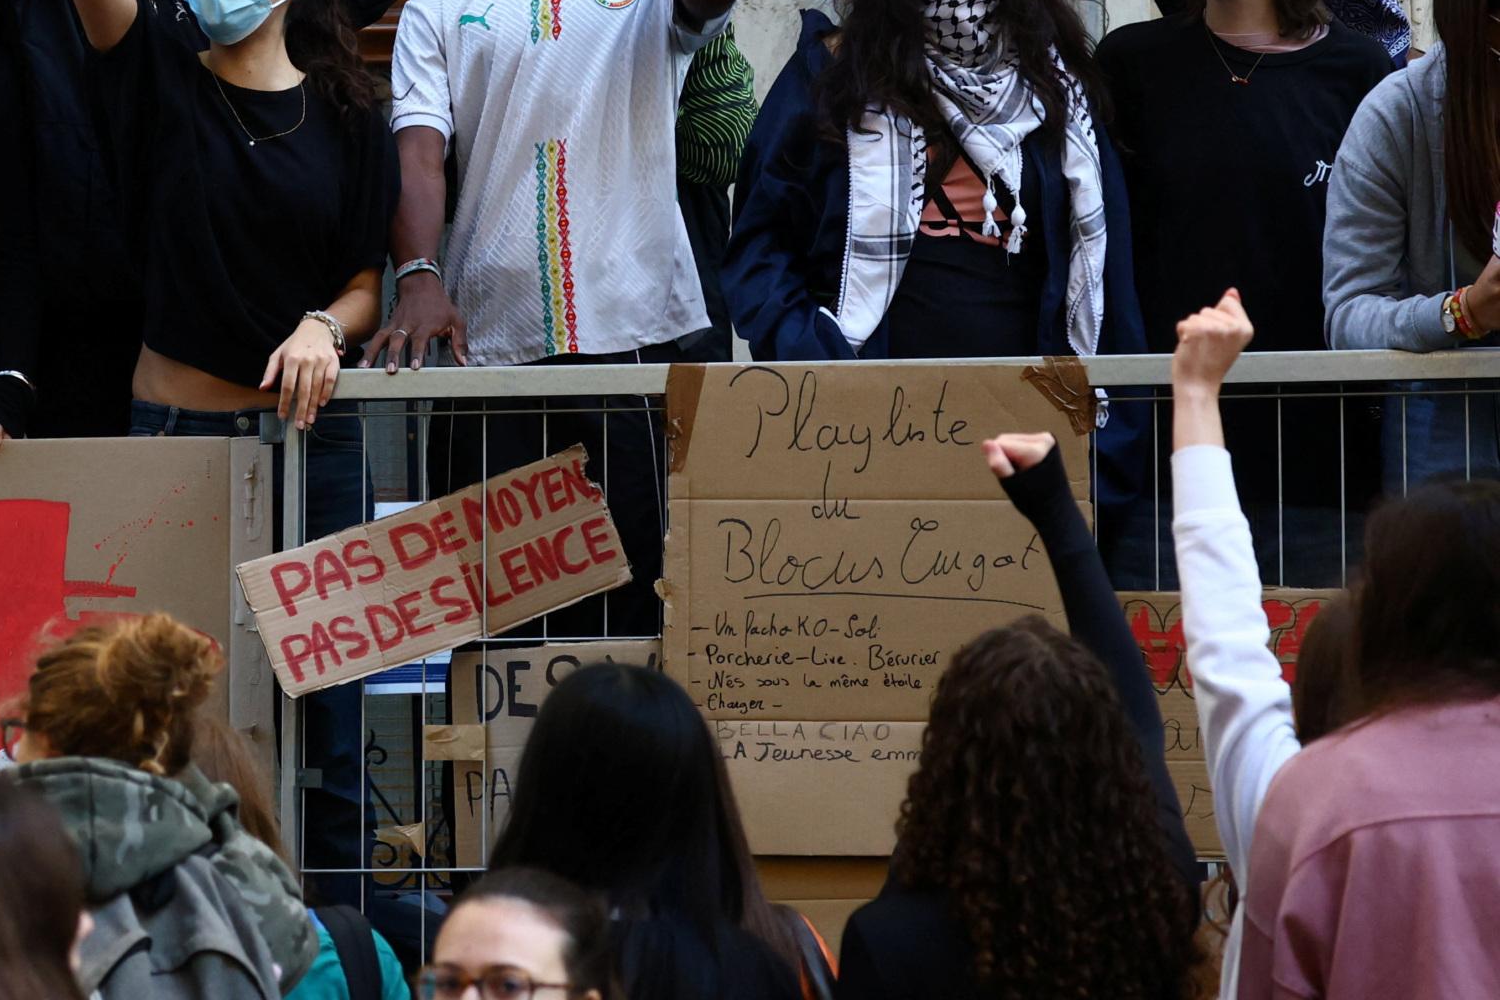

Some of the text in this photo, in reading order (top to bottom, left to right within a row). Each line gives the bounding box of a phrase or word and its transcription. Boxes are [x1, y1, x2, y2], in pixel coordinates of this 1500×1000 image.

[811, 461, 861, 520] du
[270, 539, 386, 617] PAS
[388, 510, 467, 570] DE
[718, 518, 883, 589] Blocus
[280, 616, 370, 683] PAS
[364, 590, 435, 652] DE
[708, 671, 745, 690] Nés
[758, 678, 790, 687] sous
[830, 674, 869, 687] même
[716, 720, 890, 742] BELLA CIAO
